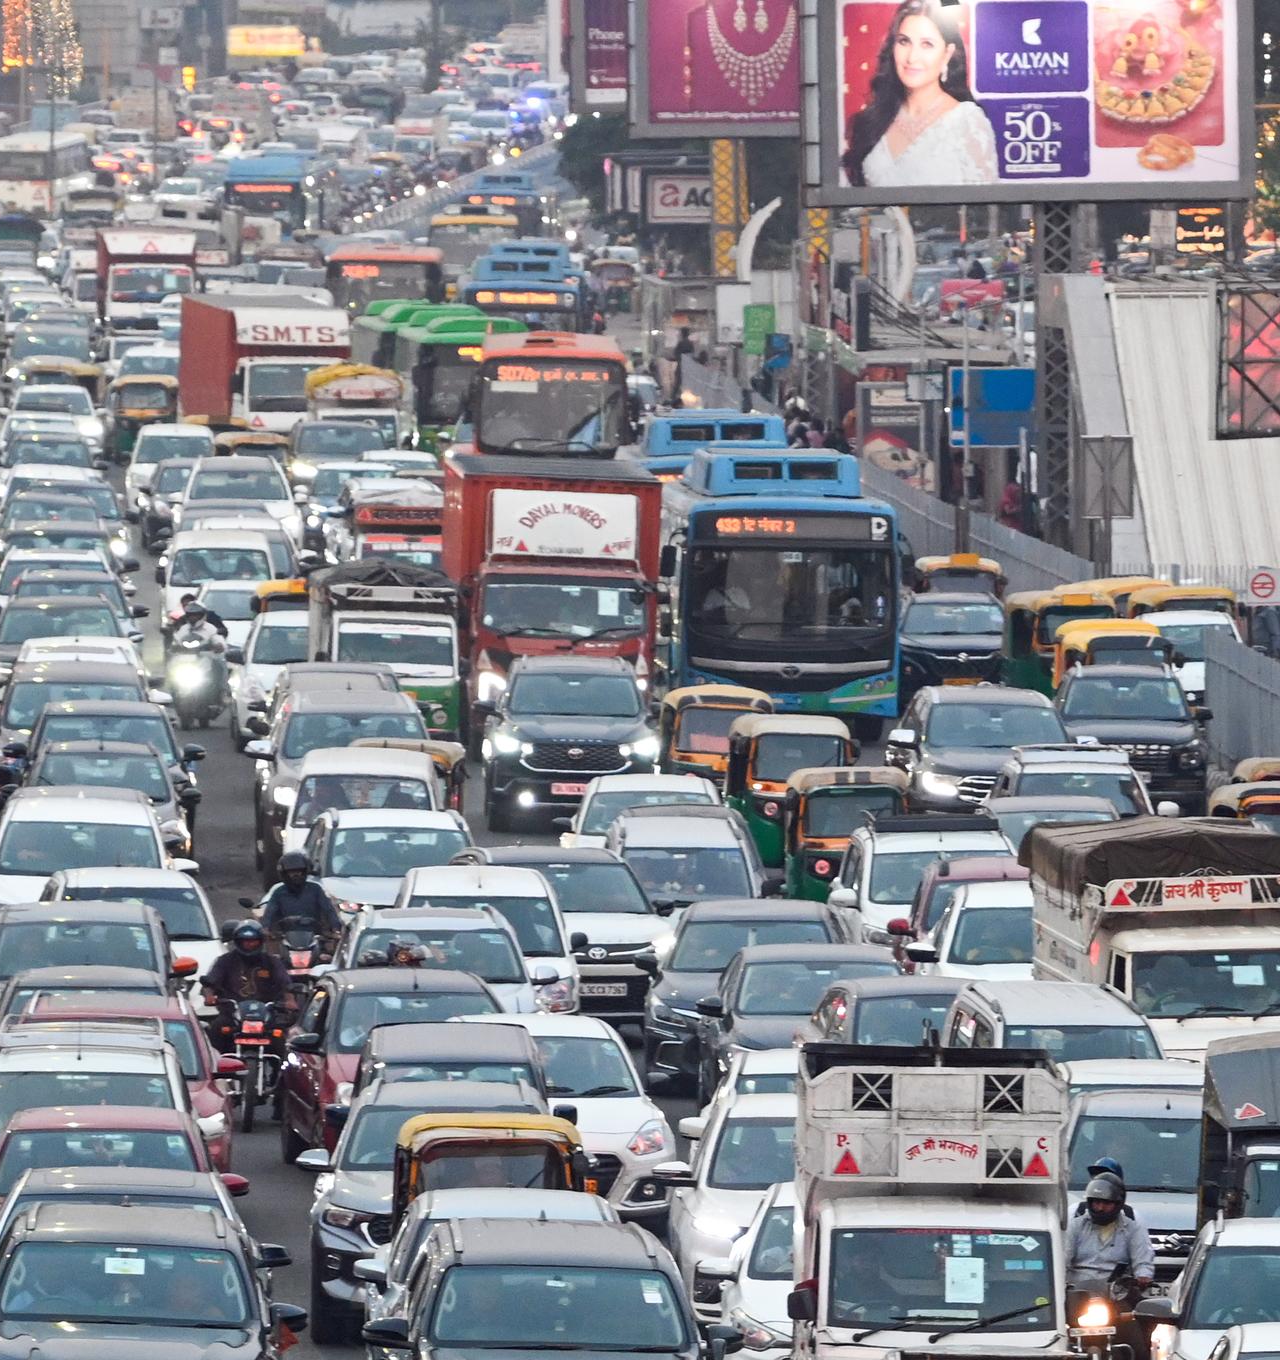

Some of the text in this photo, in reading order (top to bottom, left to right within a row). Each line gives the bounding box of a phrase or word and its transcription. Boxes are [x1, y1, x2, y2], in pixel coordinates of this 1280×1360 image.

[995, 52, 1069, 69] KALYAN
[1004, 141, 1062, 164] OFF
[518, 503, 559, 529] DAYAL
[1164, 884, 1187, 899] जय
[1188, 880, 1205, 899] श्री
[836, 1134, 851, 1147] P.
[1036, 1137, 1049, 1152] C.
